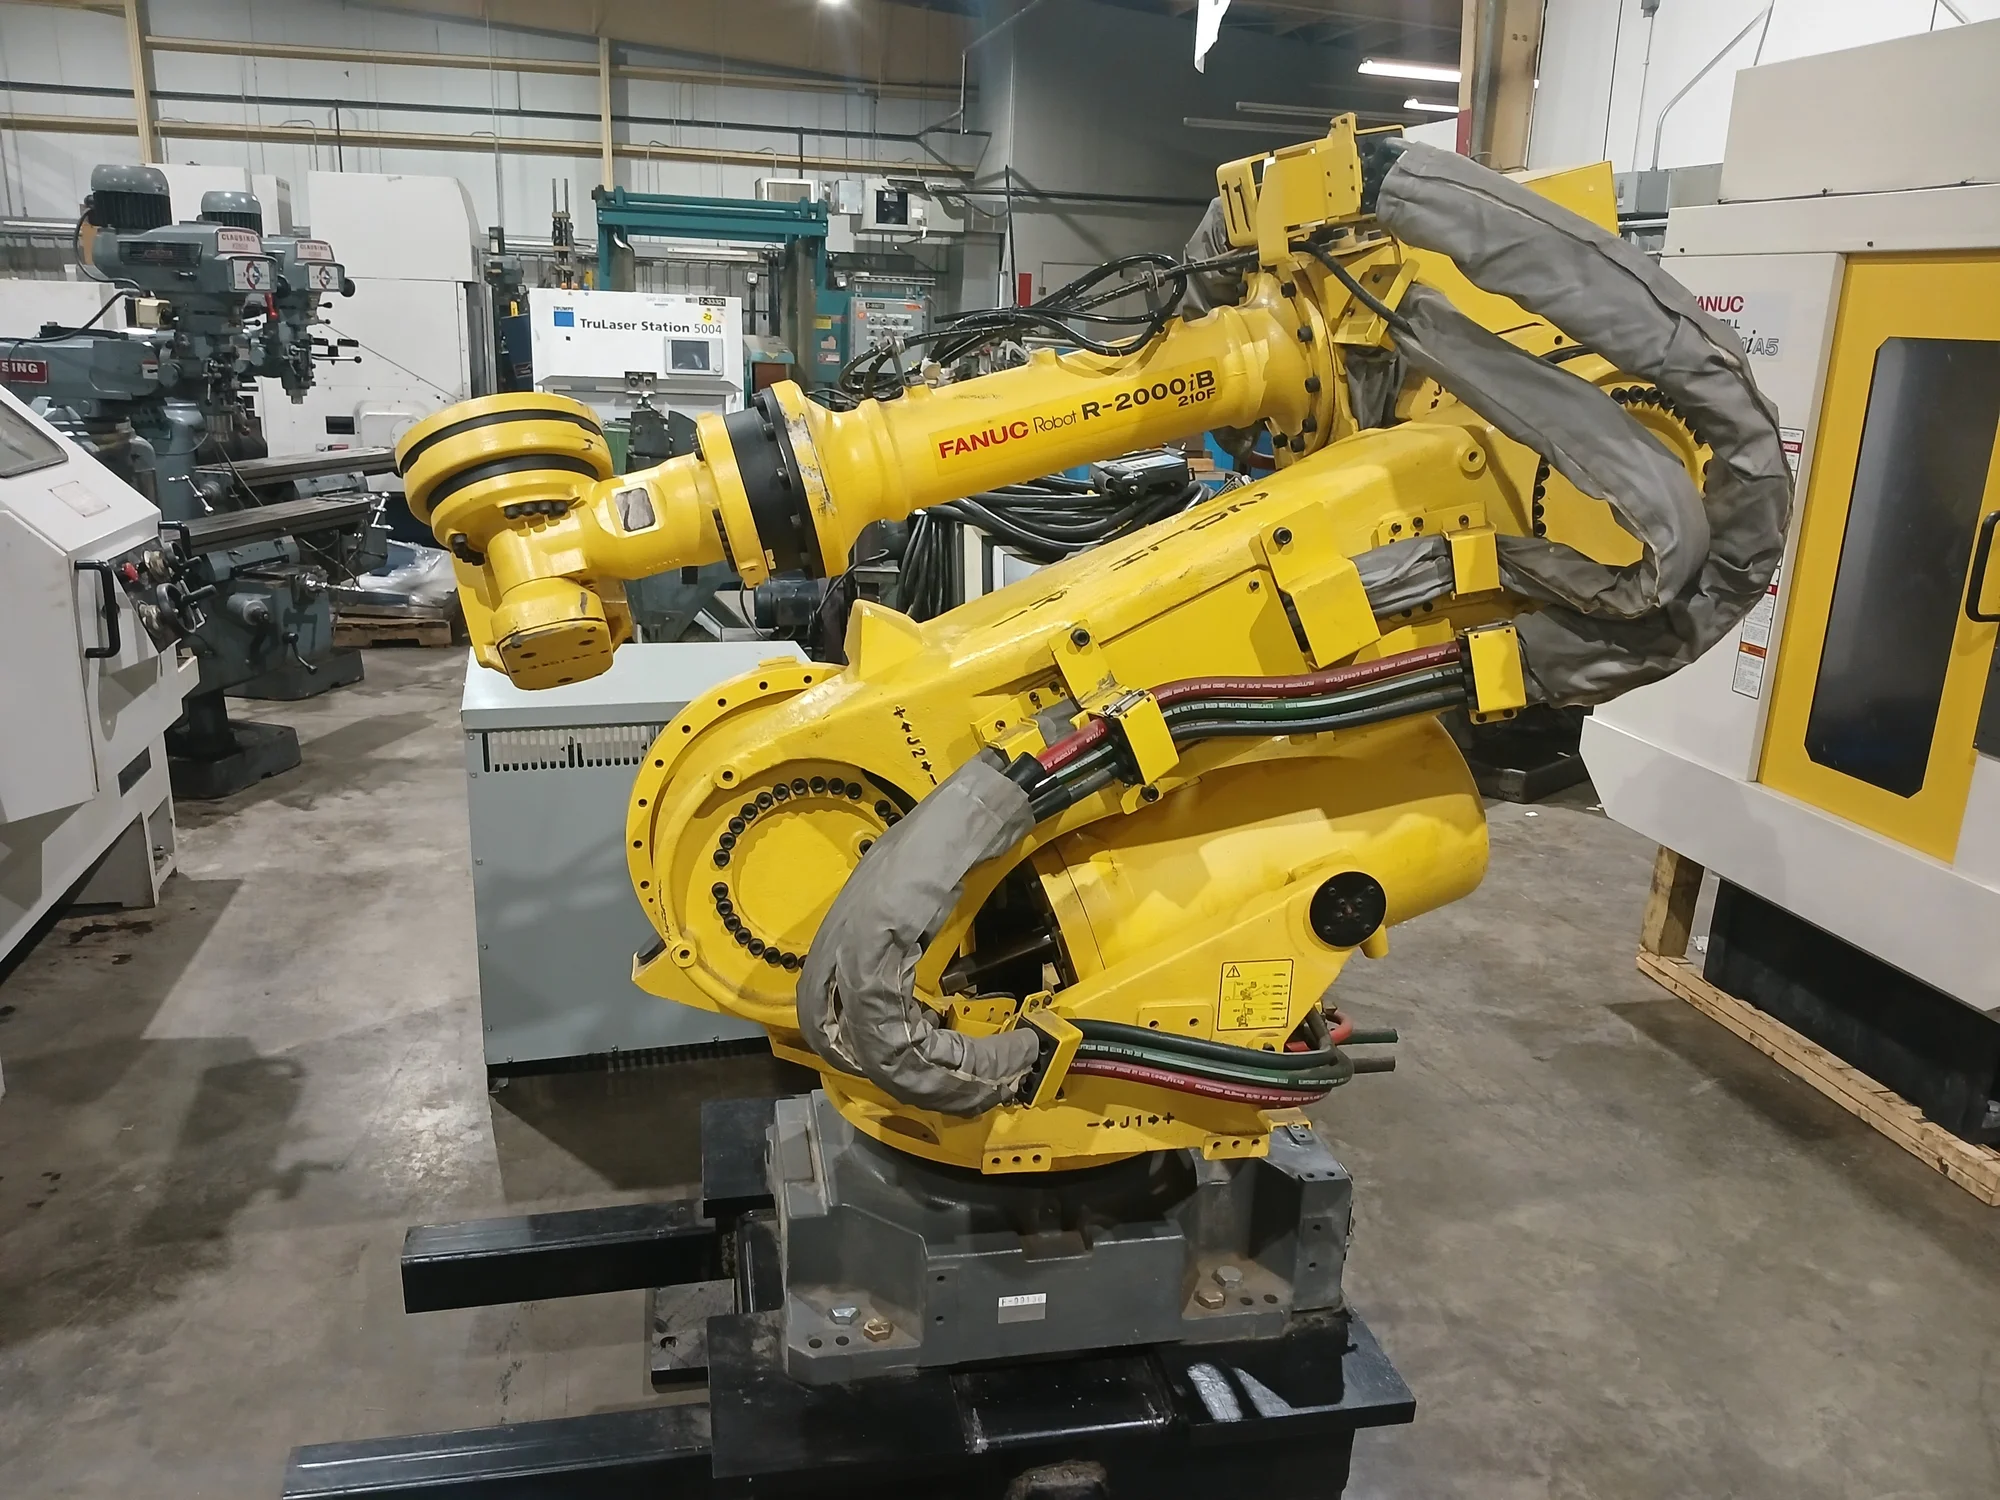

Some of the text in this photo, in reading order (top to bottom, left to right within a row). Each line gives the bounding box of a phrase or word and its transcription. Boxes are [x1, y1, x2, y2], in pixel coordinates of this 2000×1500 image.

[580, 318, 723, 335] TruLaser Station 5004
[1177, 387, 1217, 408] 210F
[938, 370, 1216, 459] FANUC Robot R-2000iB
[1325, 670, 1361, 684] GOODYEAR
[906, 736, 927, 759] J2
[1151, 1072, 1185, 1086] GOODYEAR
[1194, 1083, 1224, 1094] AUTOGRIP
[1119, 1114, 1142, 1129] J1
